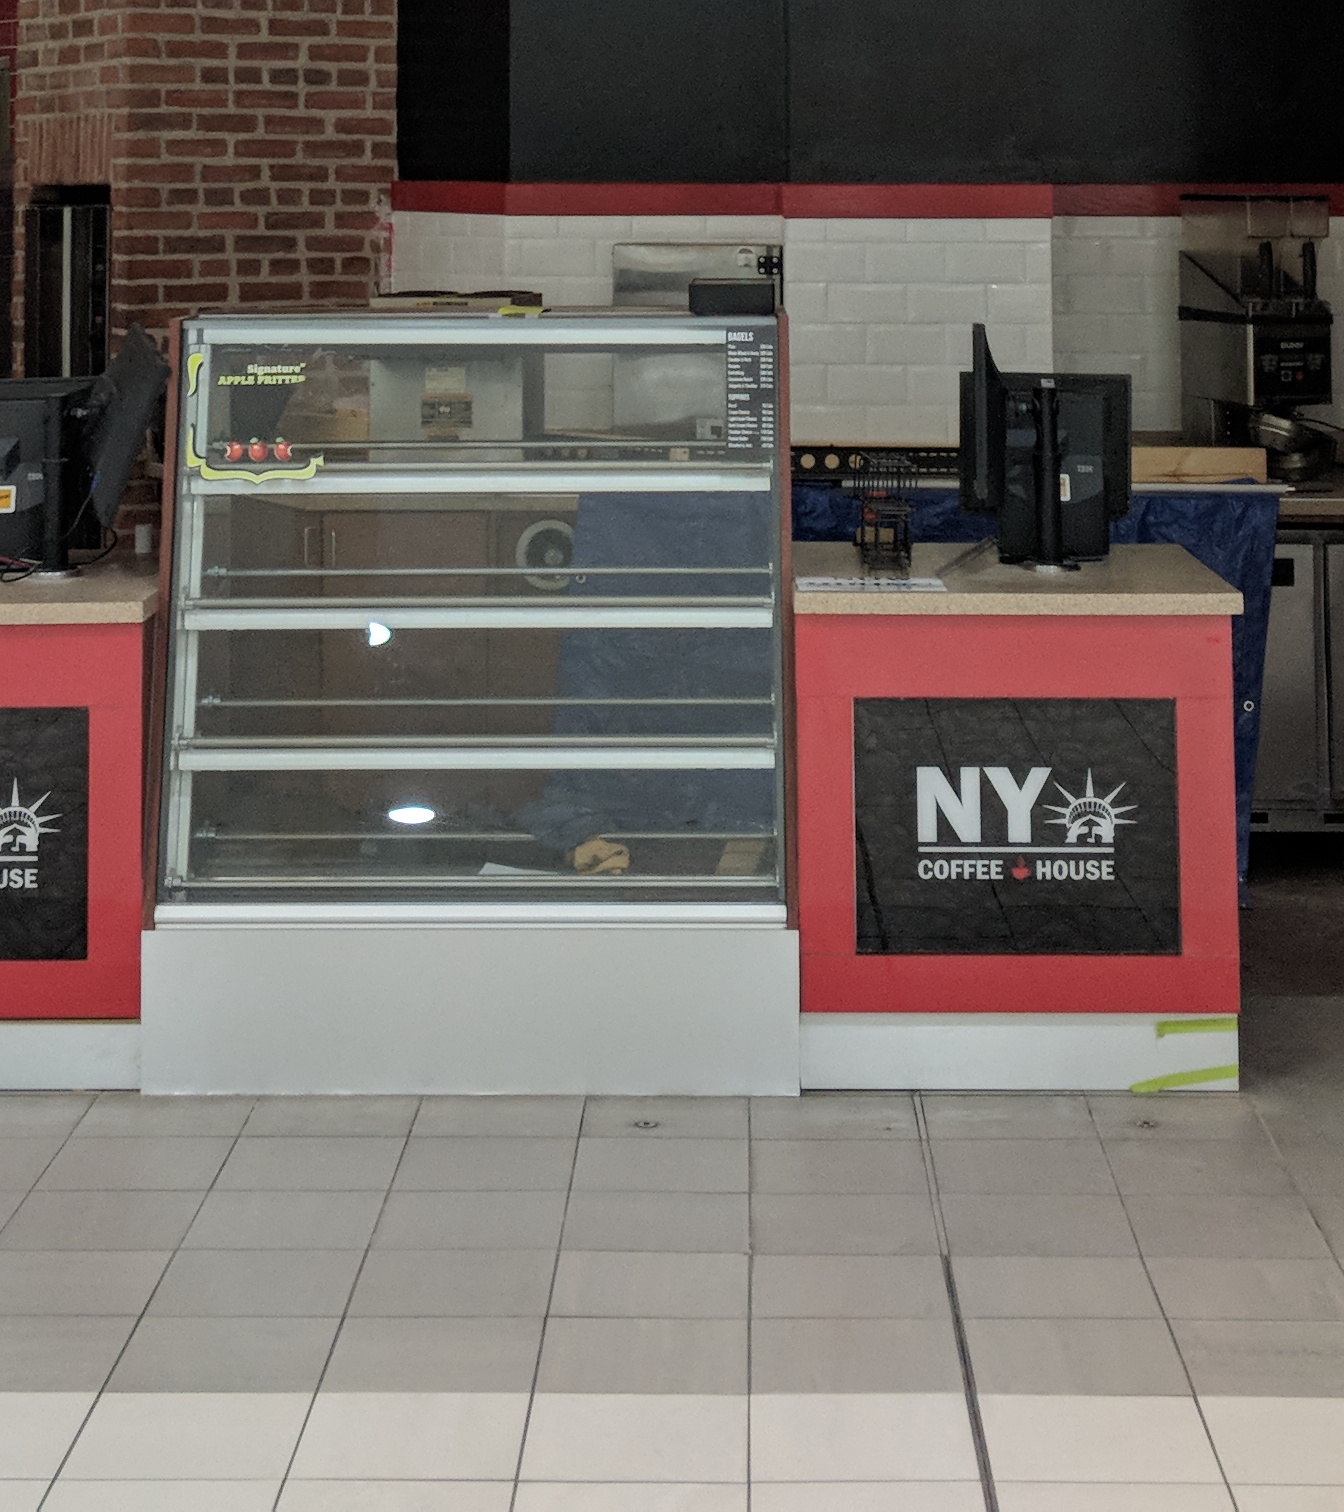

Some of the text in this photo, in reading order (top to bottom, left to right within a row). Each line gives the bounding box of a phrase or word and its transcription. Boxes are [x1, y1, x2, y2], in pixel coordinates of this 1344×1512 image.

[217, 375, 256, 386] APPLE
[916, 765, 1053, 844] NY
[917, 858, 1115, 880] COFFEE HOUSE
